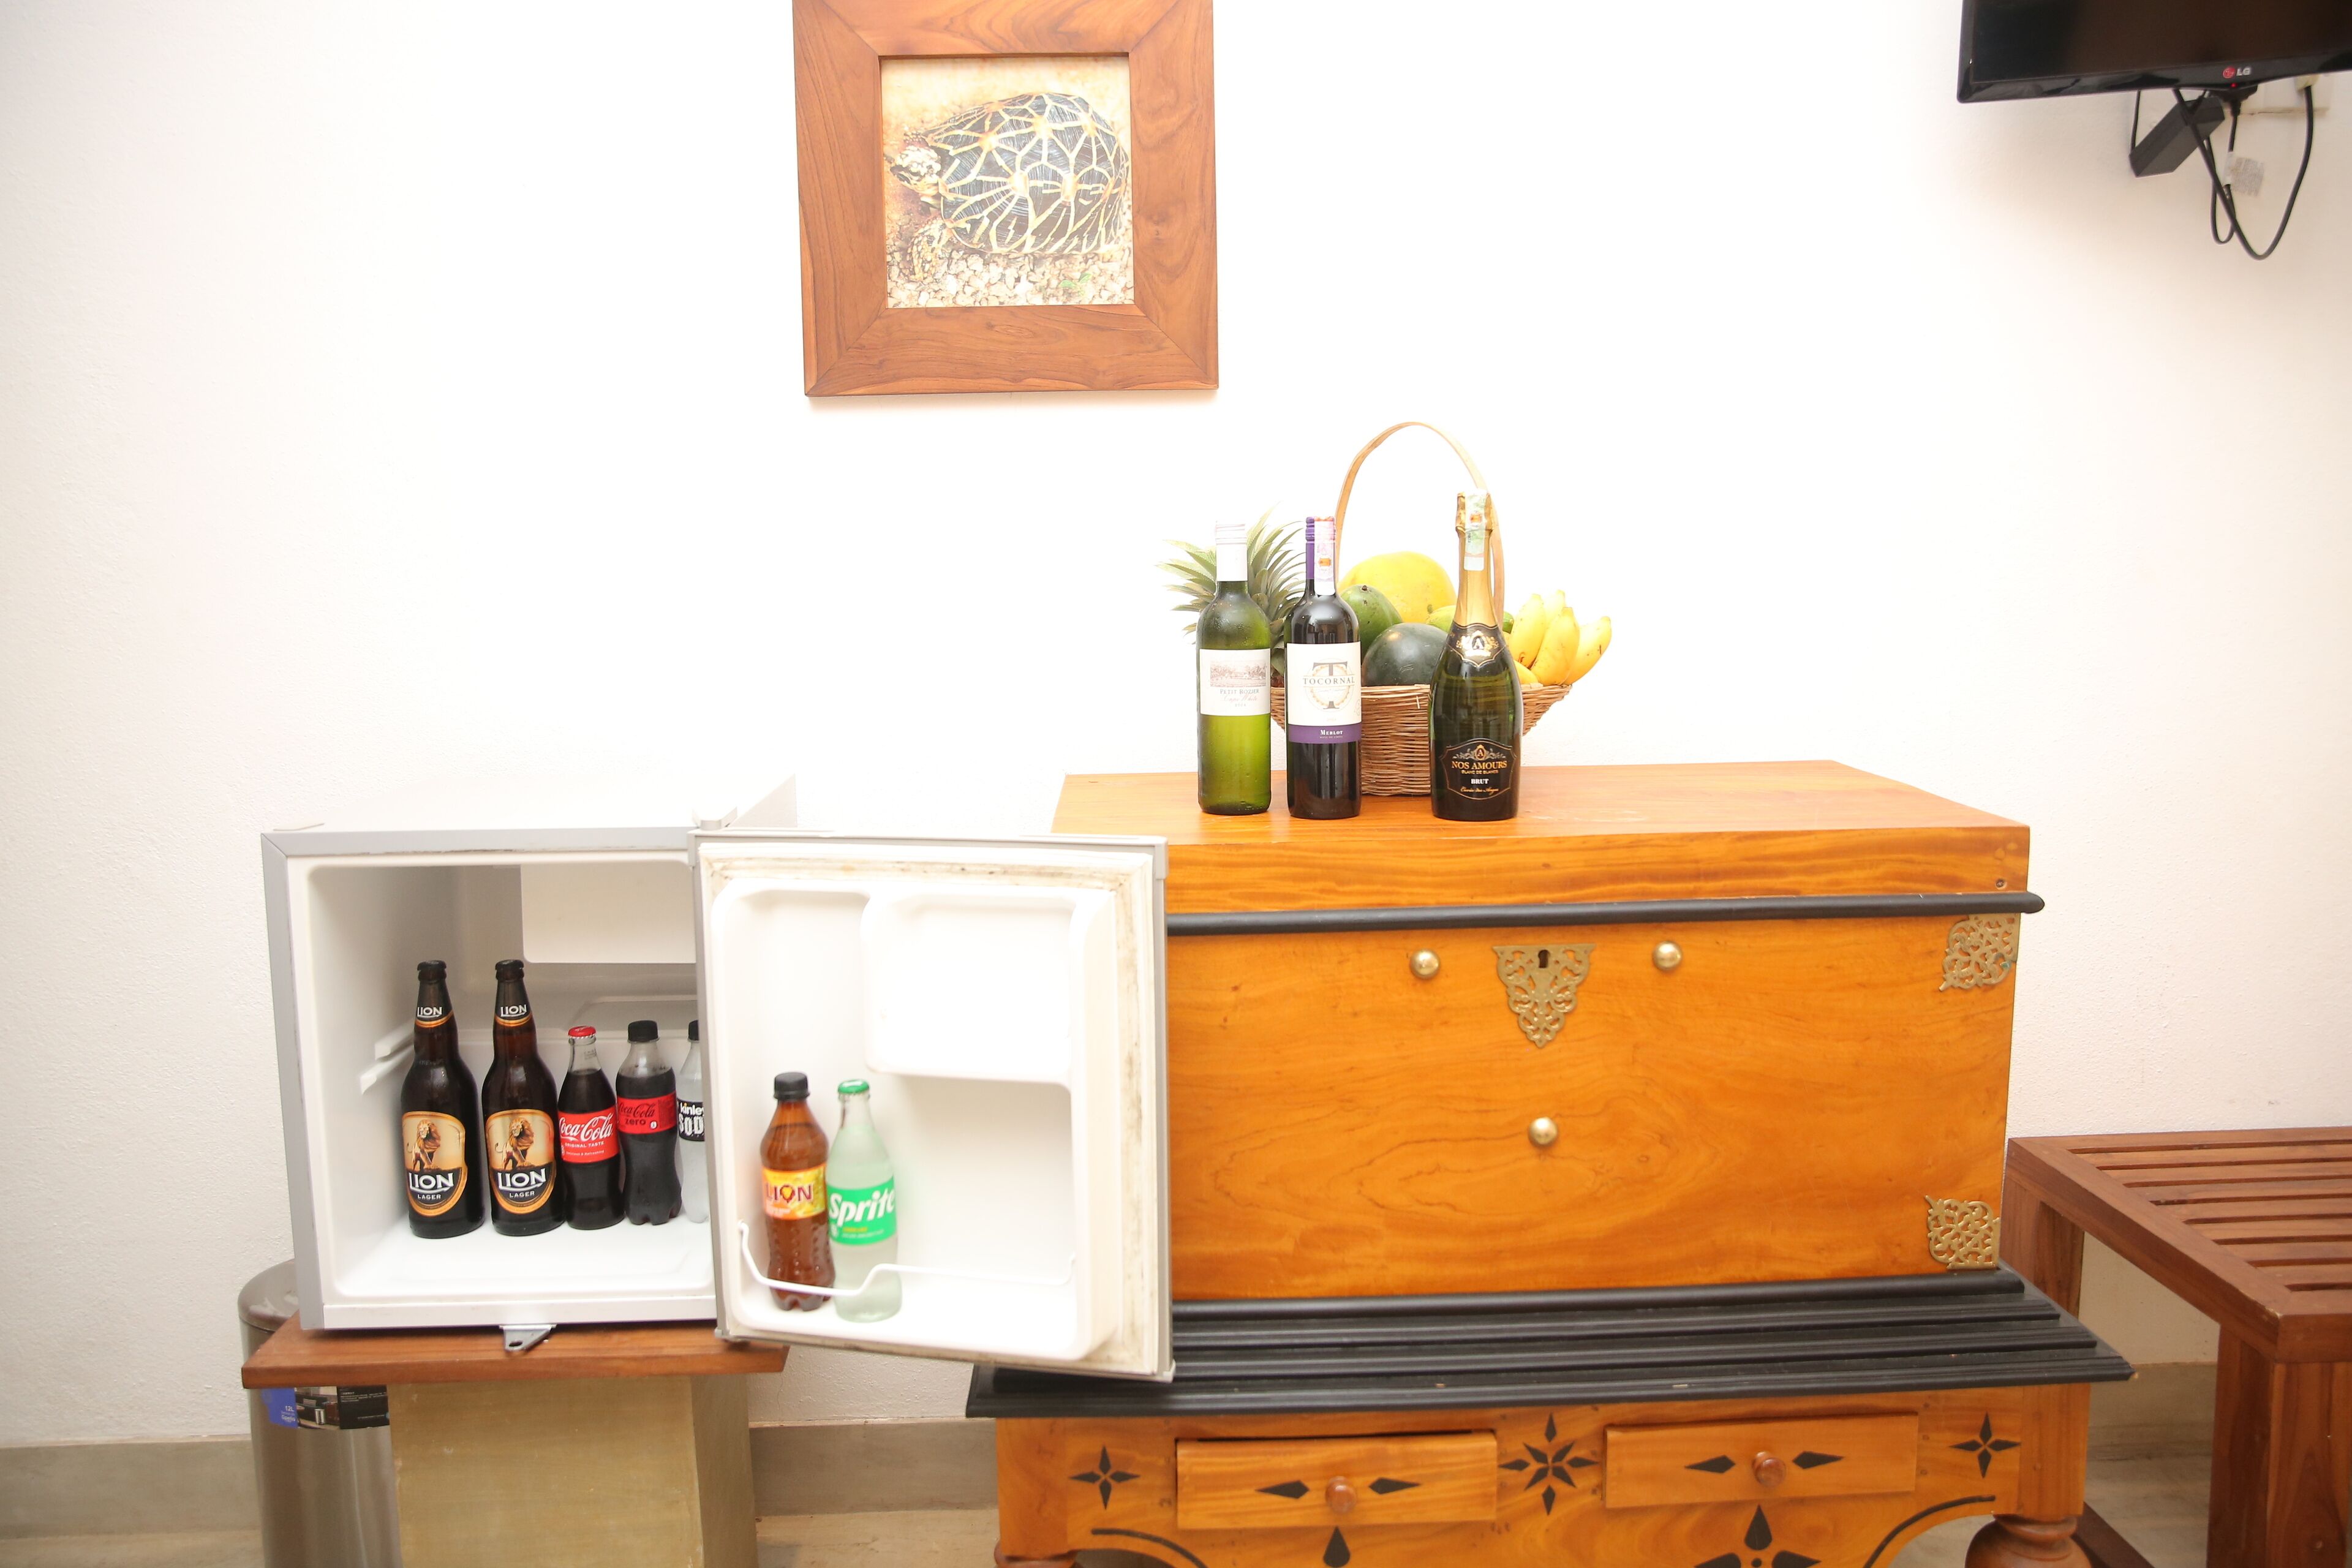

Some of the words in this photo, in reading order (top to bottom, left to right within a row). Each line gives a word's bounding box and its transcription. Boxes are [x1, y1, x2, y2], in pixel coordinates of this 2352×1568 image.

[2236, 66, 2252, 77] LG
[1303, 676, 1355, 685] TOCORNAL
[1452, 761, 1470, 769] NOS
[1471, 761, 1507, 770] AMOURS
[417, 1006, 442, 1018] LION
[500, 1004, 527, 1017] LION
[559, 1112, 614, 1142] Coca-Cola
[679, 1113, 704, 1136] SOD
[409, 1172, 454, 1194] LION
[497, 1168, 546, 1192] LION
[766, 1183, 813, 1204] LION
[829, 1188, 894, 1227] Sprite
